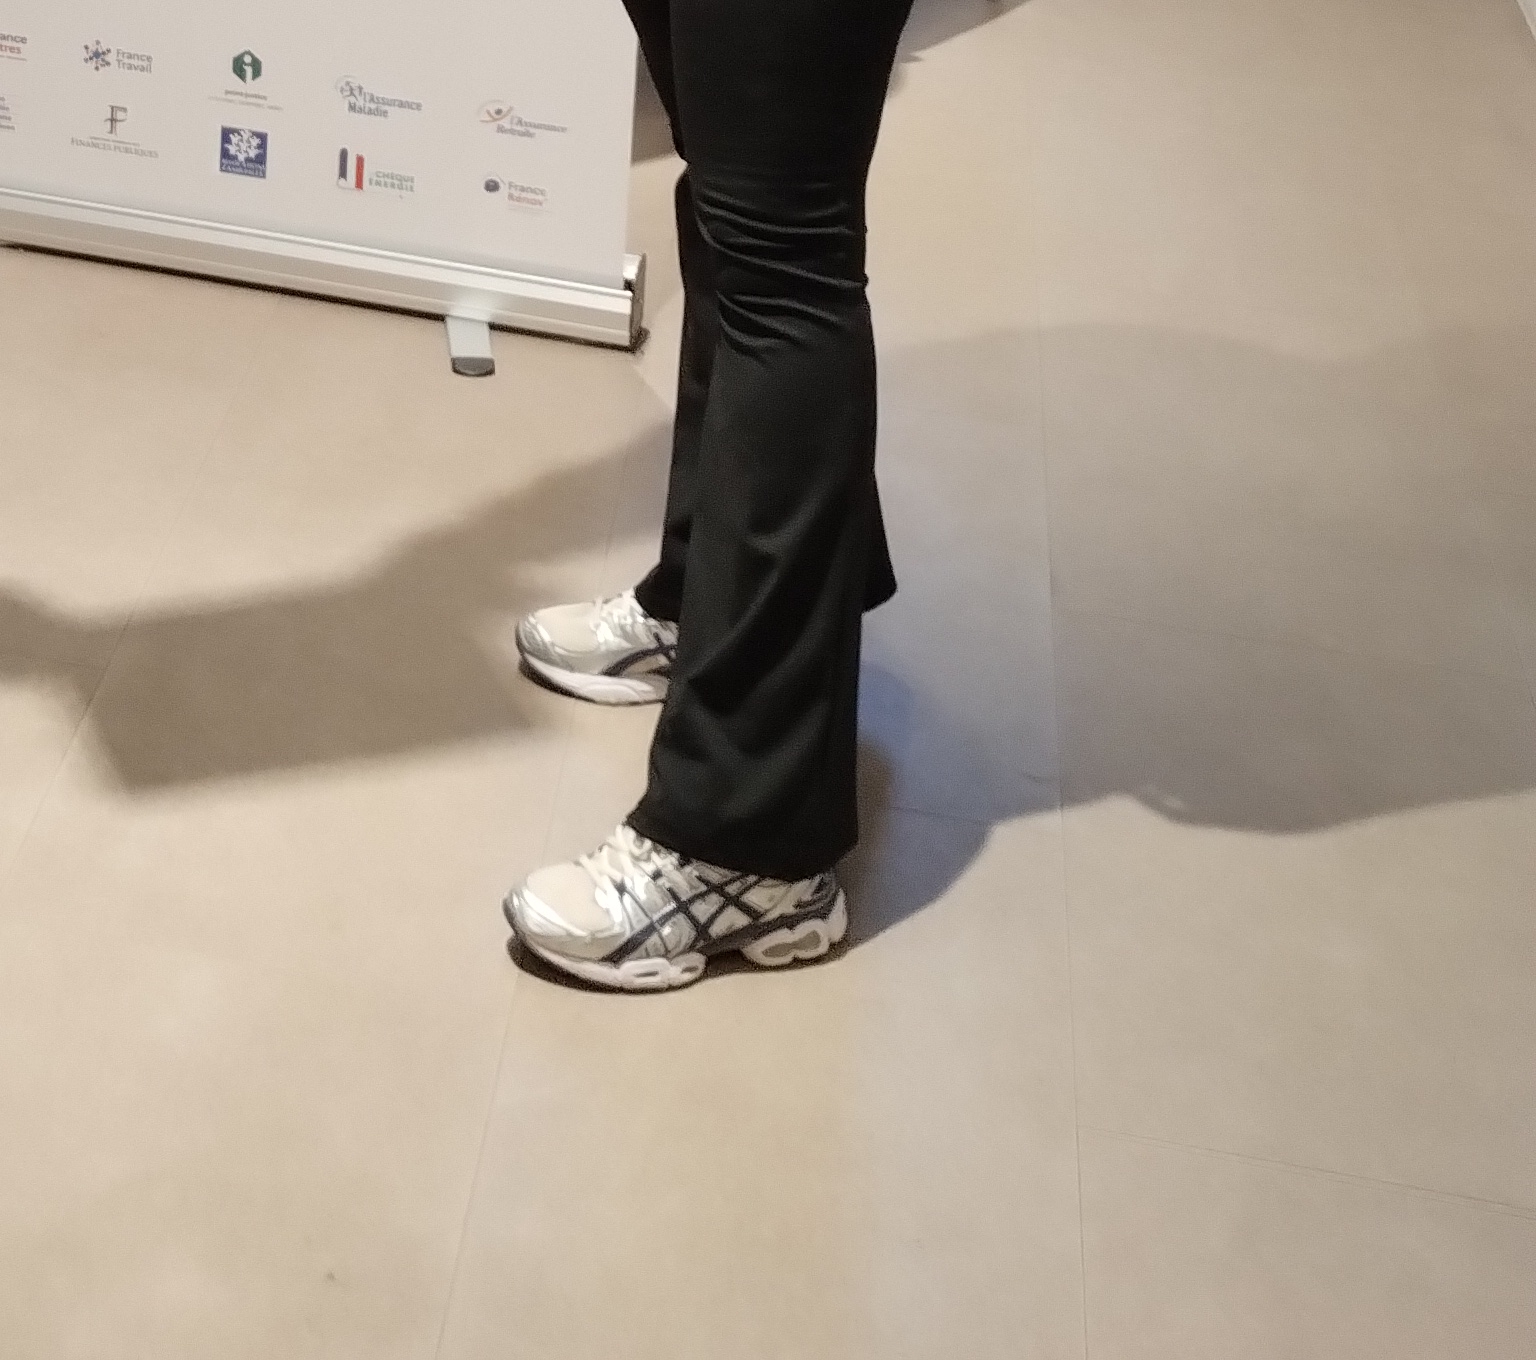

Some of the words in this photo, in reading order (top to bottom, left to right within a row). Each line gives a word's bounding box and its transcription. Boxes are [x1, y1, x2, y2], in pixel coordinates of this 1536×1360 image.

[116, 48, 154, 63] France
[116, 59, 152, 74] Travail
[348, 101, 389, 118] Maladie
[364, 91, 423, 112] l'Assurance
[70, 137, 112, 152] FINANCES
[113, 141, 159, 159] PUBLIQUES
